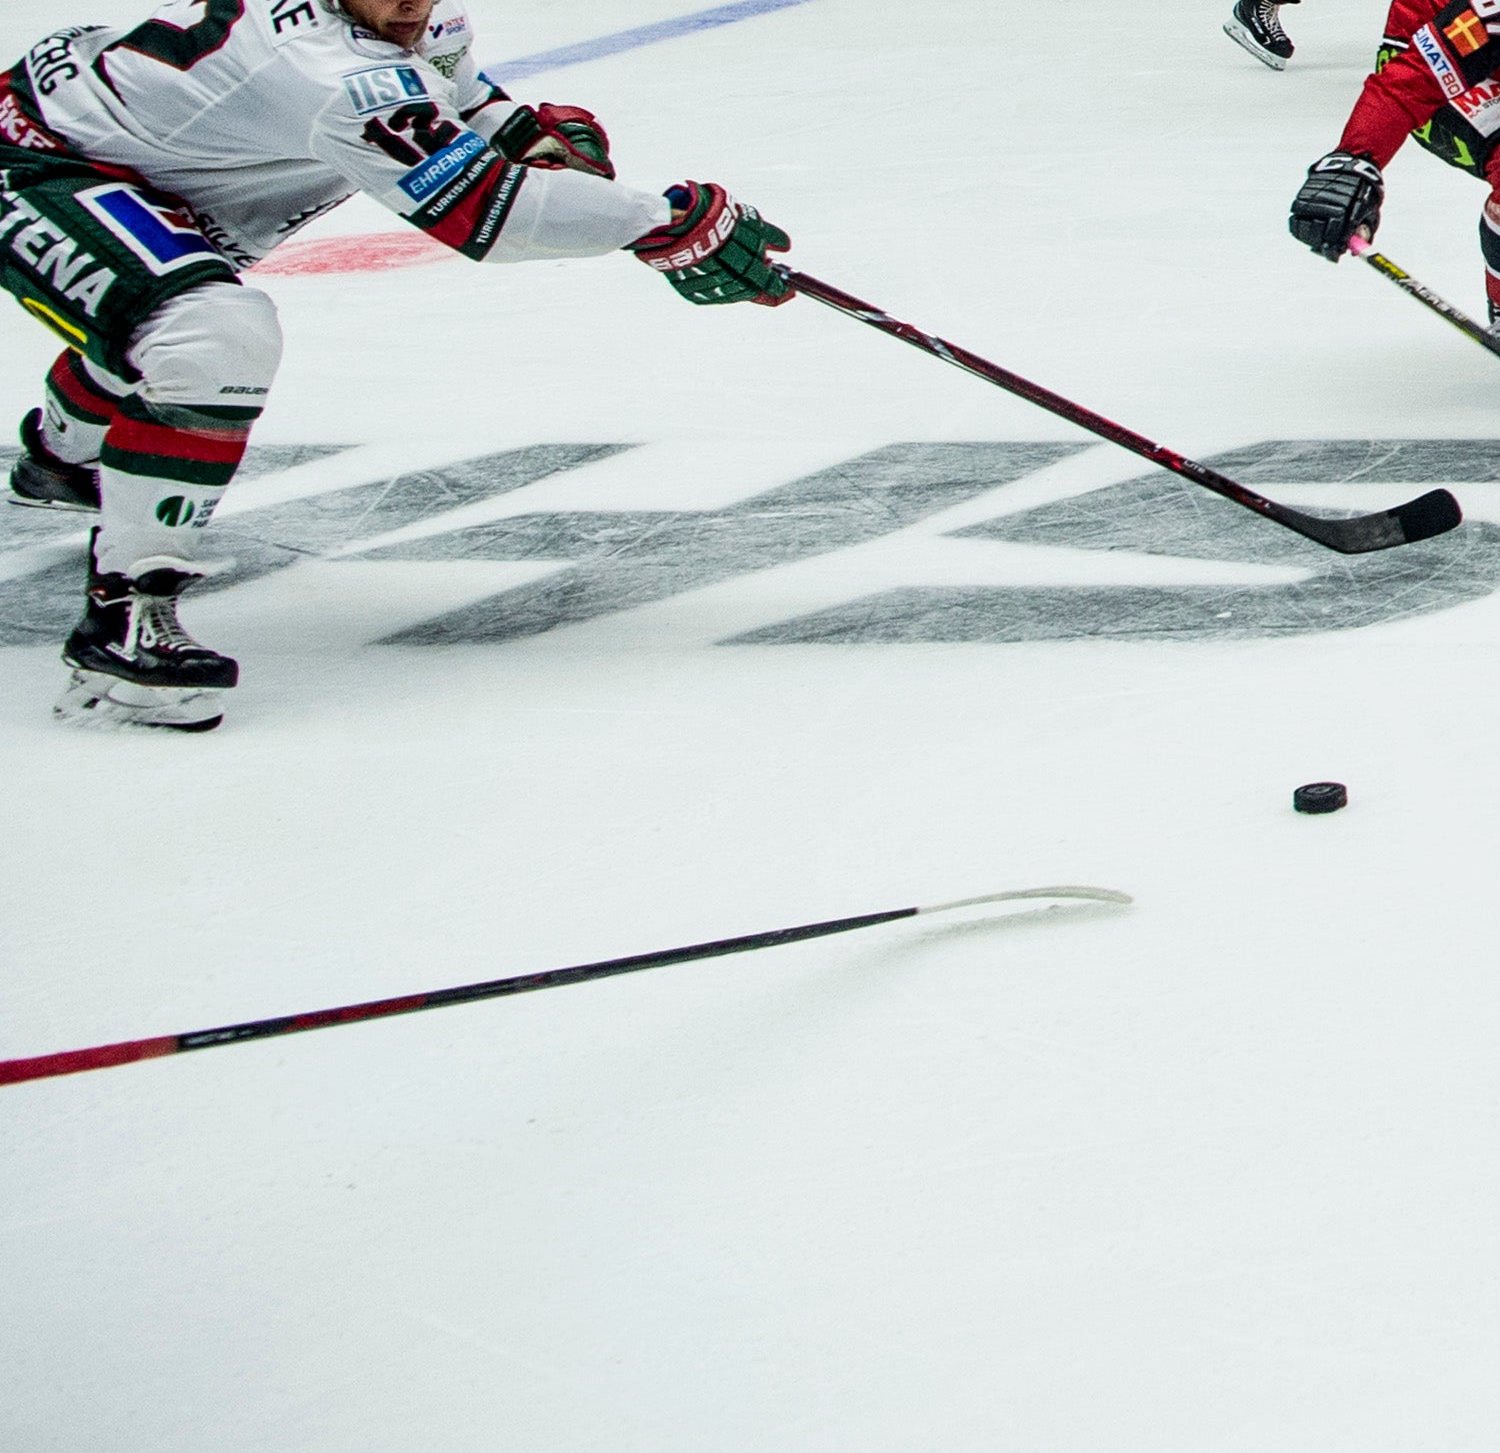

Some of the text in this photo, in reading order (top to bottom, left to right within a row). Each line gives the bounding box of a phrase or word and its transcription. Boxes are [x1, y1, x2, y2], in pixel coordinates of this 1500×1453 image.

[360, 101, 462, 167] 12
[409, 134, 488, 195] EHRENBORG
[426, 177, 471, 218] TURKISH
[476, 198, 503, 245] TURKISH
[0, 186, 118, 318] TENA
